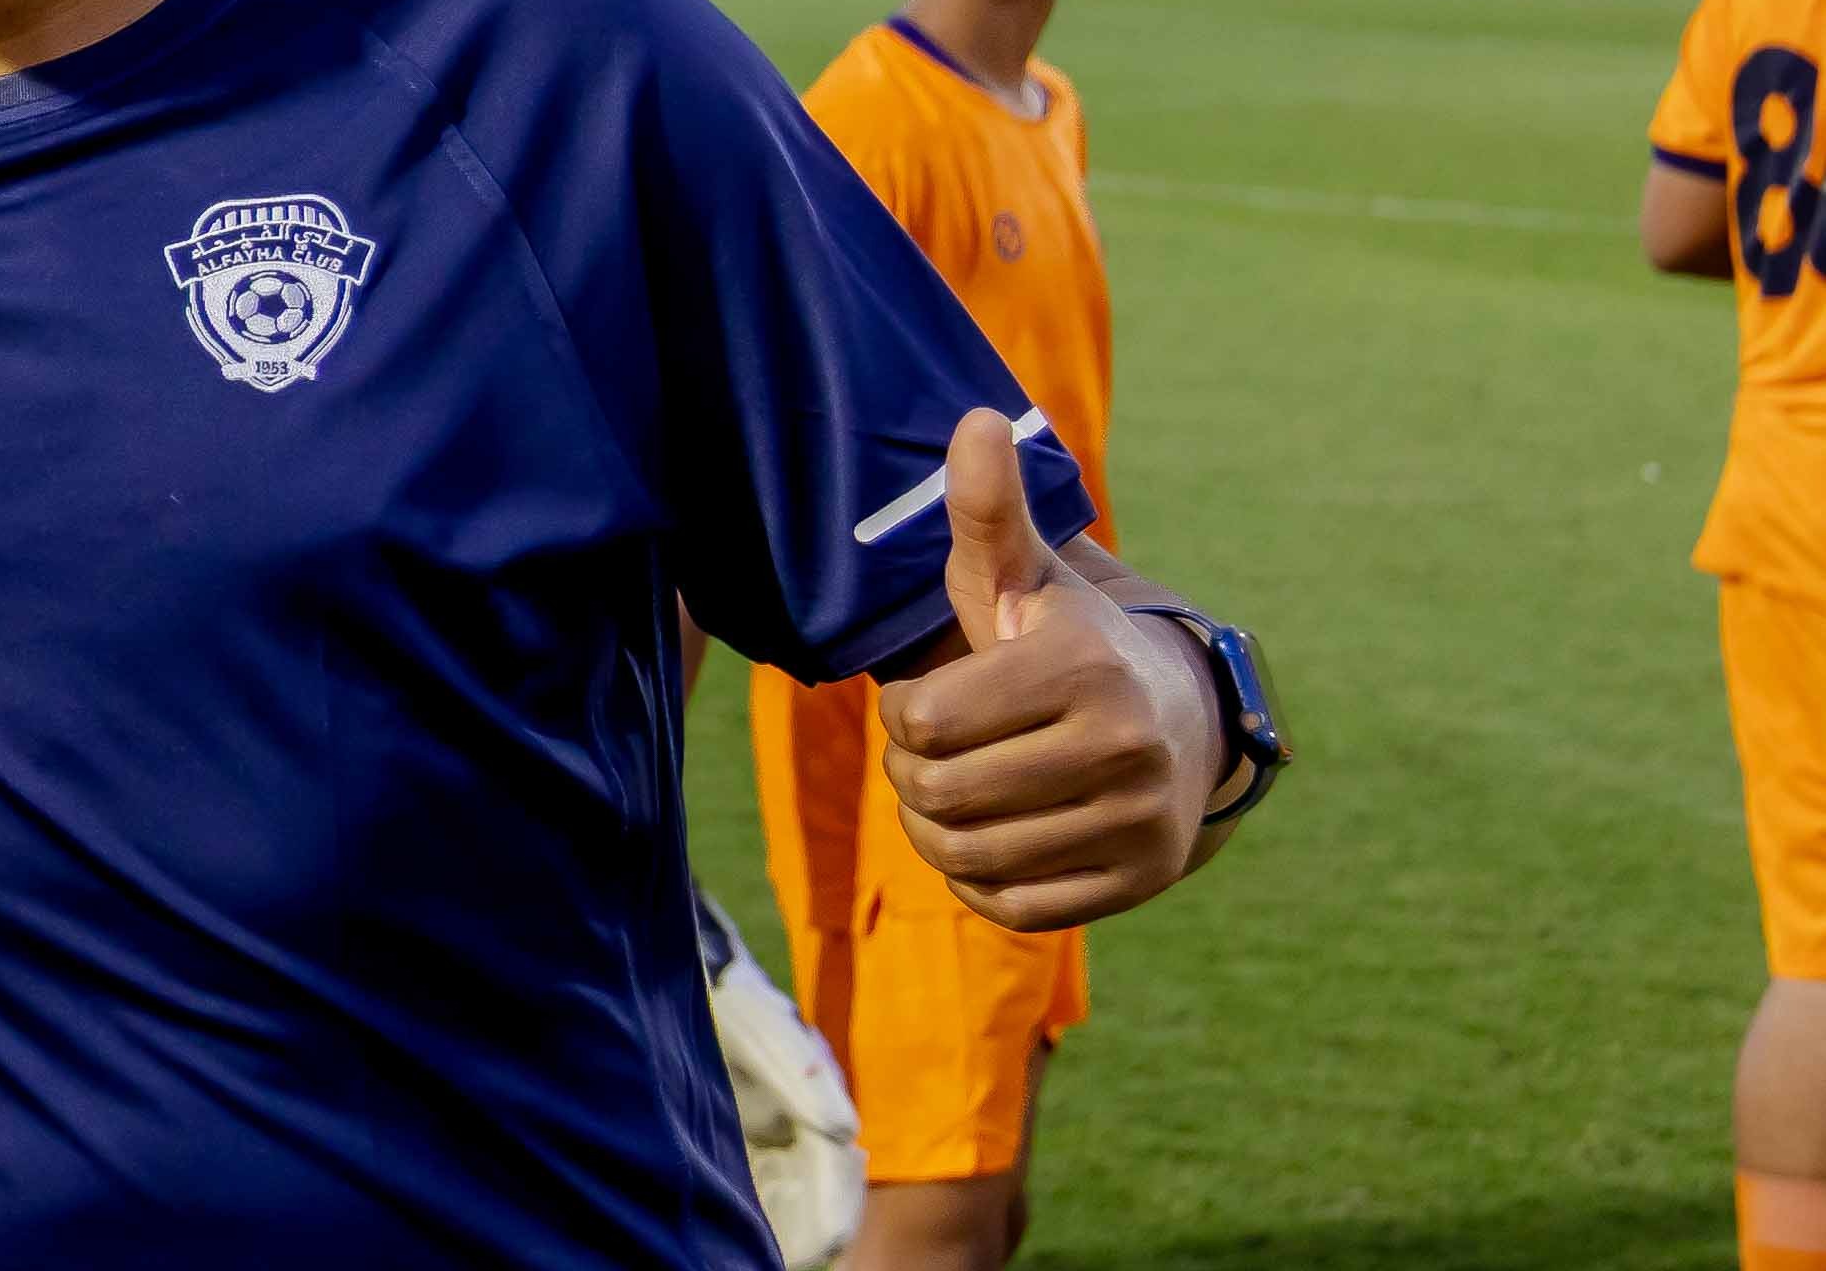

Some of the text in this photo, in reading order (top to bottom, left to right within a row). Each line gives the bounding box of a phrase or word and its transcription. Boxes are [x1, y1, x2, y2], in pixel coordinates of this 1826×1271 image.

[197, 246, 344, 276] ALFAYHA CLUB
[255, 361, 289, 375] 1953
